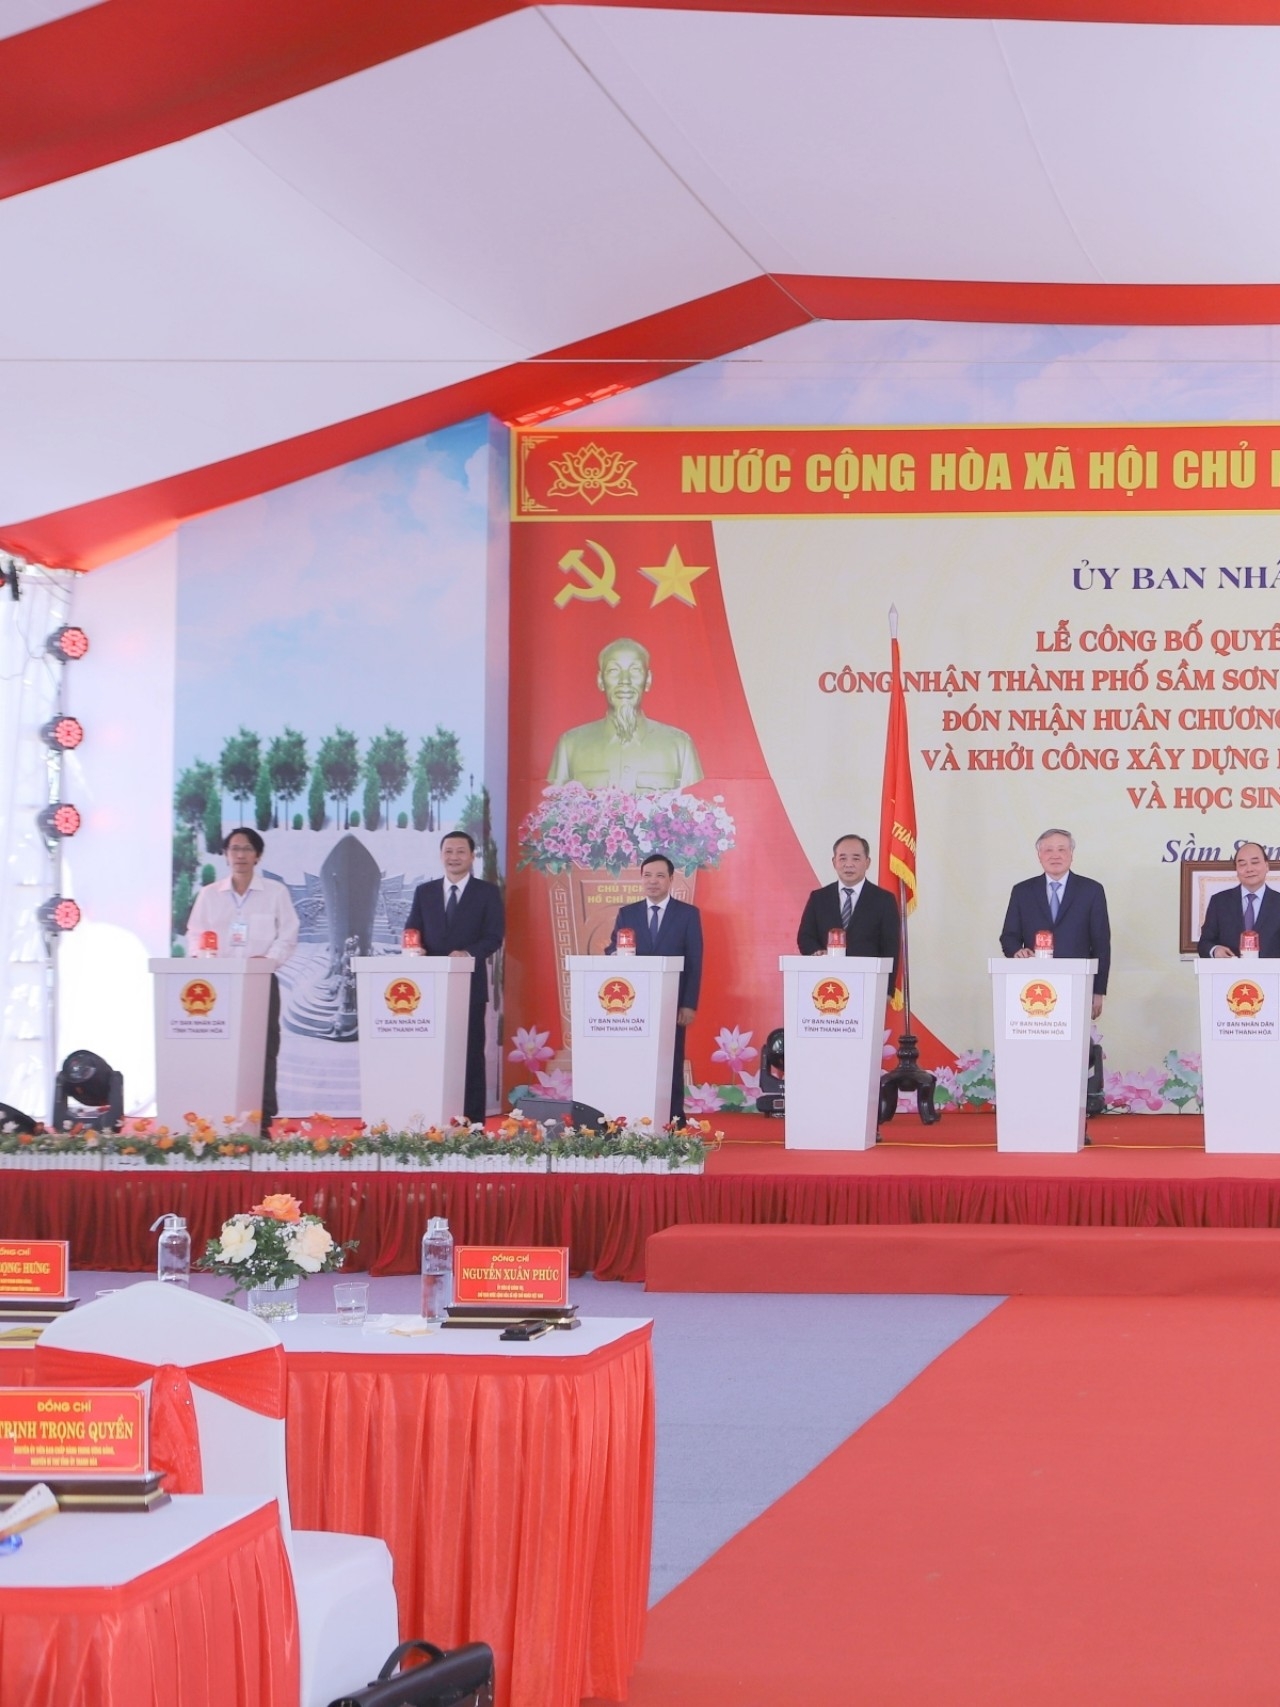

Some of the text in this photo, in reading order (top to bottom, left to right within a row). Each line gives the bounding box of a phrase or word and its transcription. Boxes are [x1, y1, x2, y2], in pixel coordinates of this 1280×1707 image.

[681, 447, 791, 494] NƯỚC
[805, 447, 915, 499] CỘNG
[930, 446, 1012, 492] HÒA
[1023, 445, 1076, 490] XÃ
[1088, 444, 1158, 497] HỘI
[1172, 440, 1256, 490] CHỦ
[1072, 561, 1120, 591] ỦY
[1131, 566, 1207, 590] BAN
[1035, 619, 1073, 653] LỄ
[1078, 623, 1158, 653] CÔNG
[1163, 618, 1204, 652] BỐ
[818, 663, 893, 694] CÔNG
[900, 663, 982, 699] NHẬN
[987, 663, 1085, 692] THÀNH
[1091, 658, 1149, 692] PHỐ
[1155, 658, 1216, 692] SẦM
[1221, 665, 1280, 692] SƠN
[941, 702, 1003, 732] ĐÓN
[1007, 702, 1088, 737] NHẬN
[1092, 702, 1172, 731] HUÂN
[920, 742, 962, 772] VÀ
[966, 741, 1035, 771] KHỞI
[1041, 741, 1120, 771] CÔNG
[1126, 741, 1186, 771] XÂY
[1191, 744, 1270, 776] DỰNG
[1126, 780, 1168, 810] VÀ
[1173, 786, 1233, 815] HỌC
[1161, 833, 1221, 863] Sầm
[0, 1262, 22, 1277] ỌNG
[462, 1263, 560, 1281] NGUYỄN XUÂN PHÚC
[516, 1254, 529, 1263] CHÍ
[72, 1400, 92, 1413] CHÍ
[0, 1414, 134, 1444] TRỊNH TRỌNG QUYỀN
